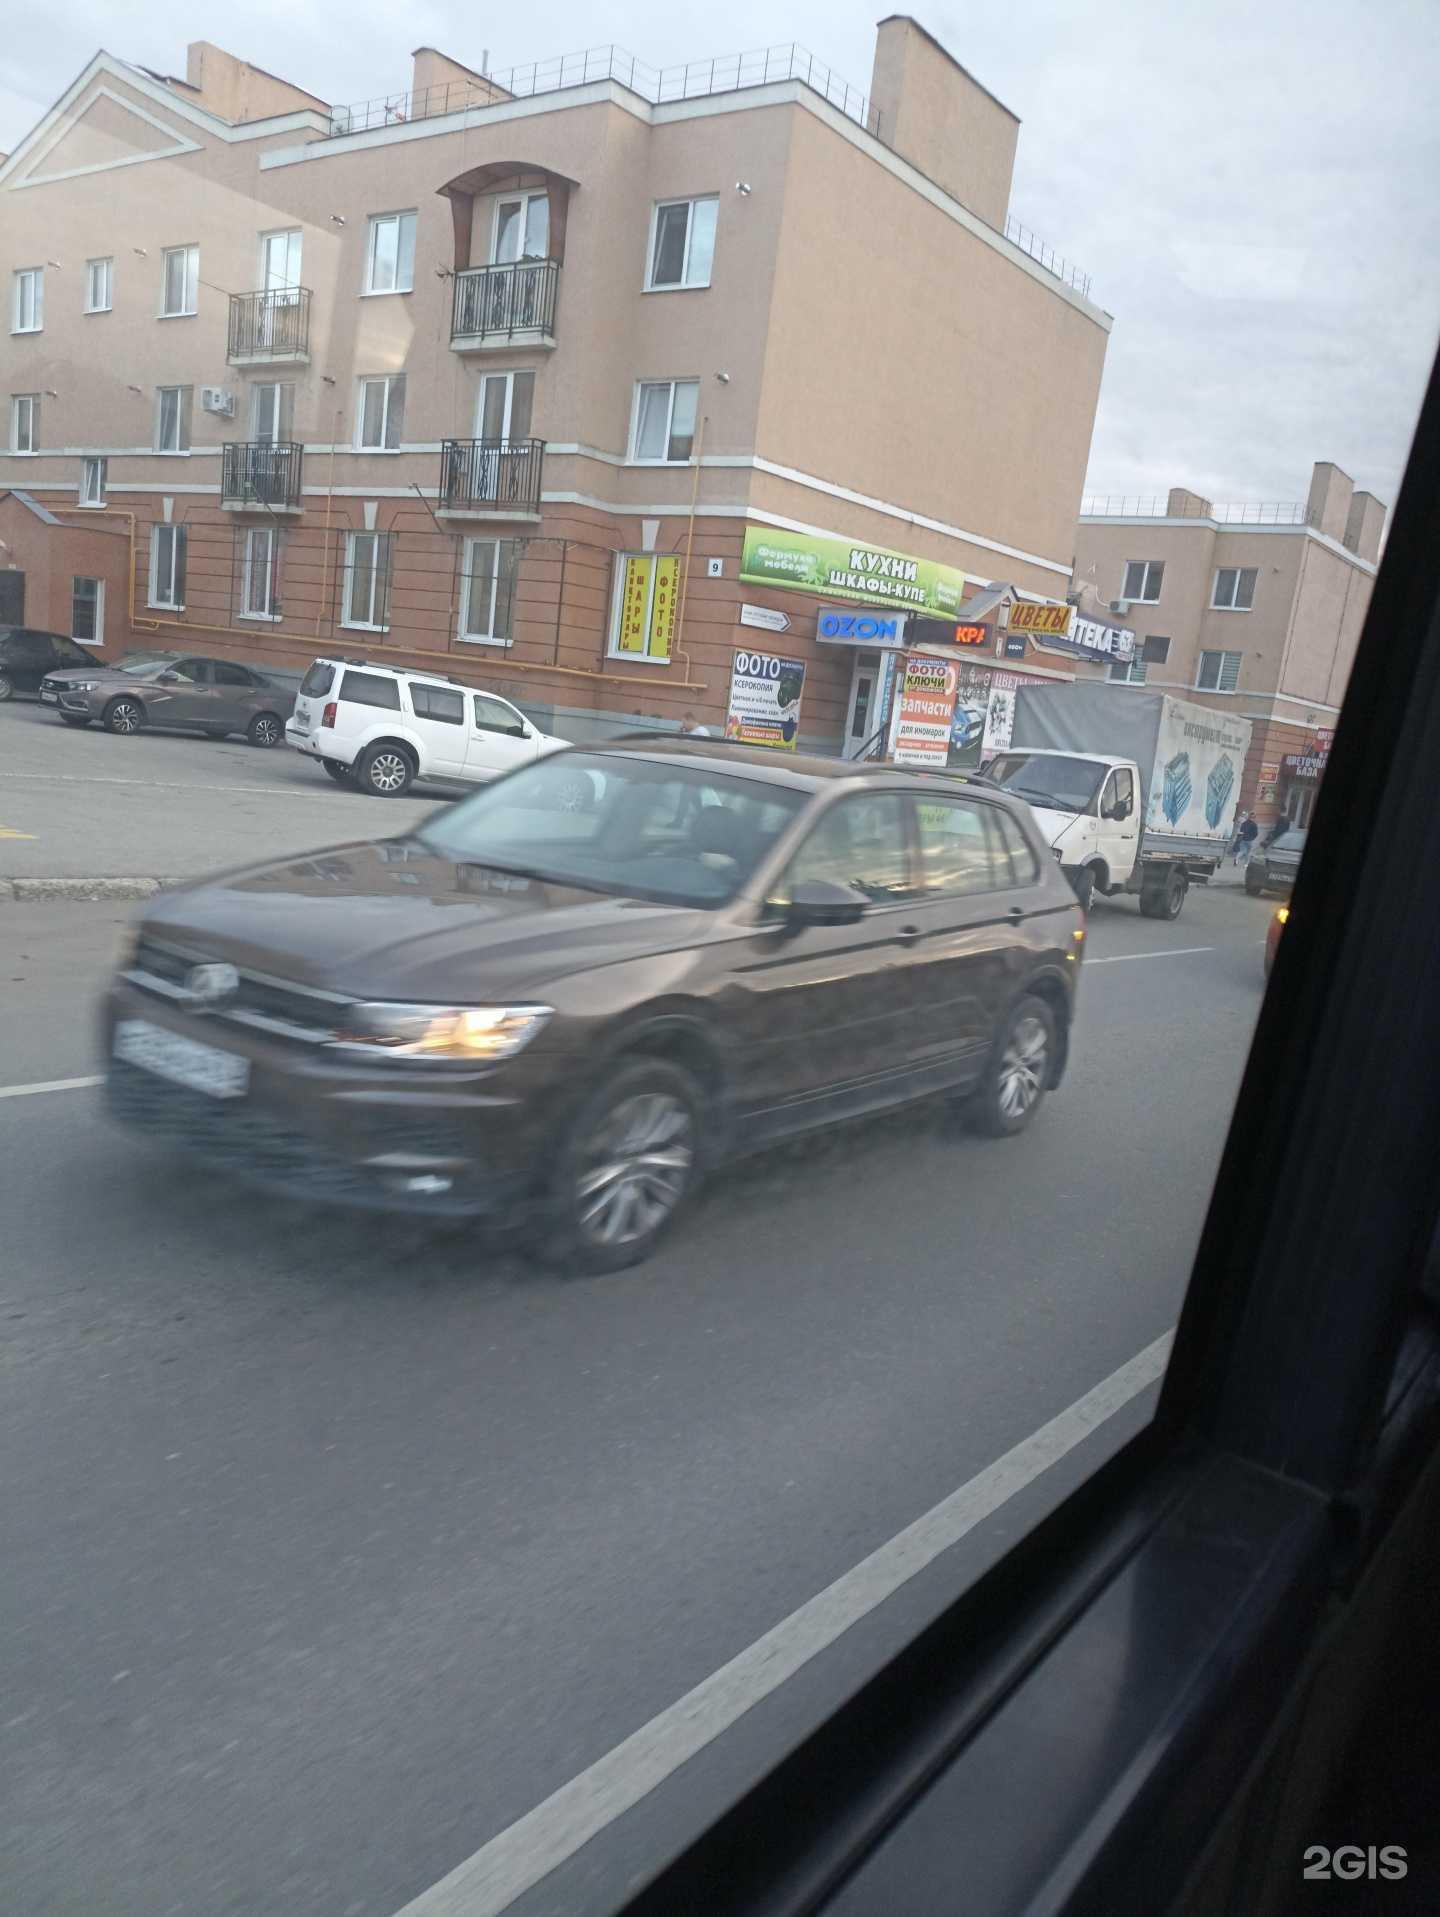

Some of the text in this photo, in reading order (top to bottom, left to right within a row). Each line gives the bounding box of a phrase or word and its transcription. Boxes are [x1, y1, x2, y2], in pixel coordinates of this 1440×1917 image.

[712, 563, 719, 572] 9
[849, 549, 918, 582] КУХНИ
[829, 571, 926, 603] ШКАФЫ-КУПЕ
[632, 576, 644, 634] ШАРЫ
[656, 576, 668, 638] ФОТО
[1012, 604, 1069, 630] ЦВЕТЫ
[821, 615, 897, 640] OZON
[736, 653, 780, 678] ФОТО
[909, 665, 945, 676] ФОТО
[734, 679, 773, 692] КСЕРОКОПИЯ
[906, 675, 945, 687] КЛЮЧИ
[900, 725, 945, 740] для иномарок
[1286, 755, 1327, 768] ЦВЕТОЧНА
[1296, 766, 1318, 777] БАЗА
